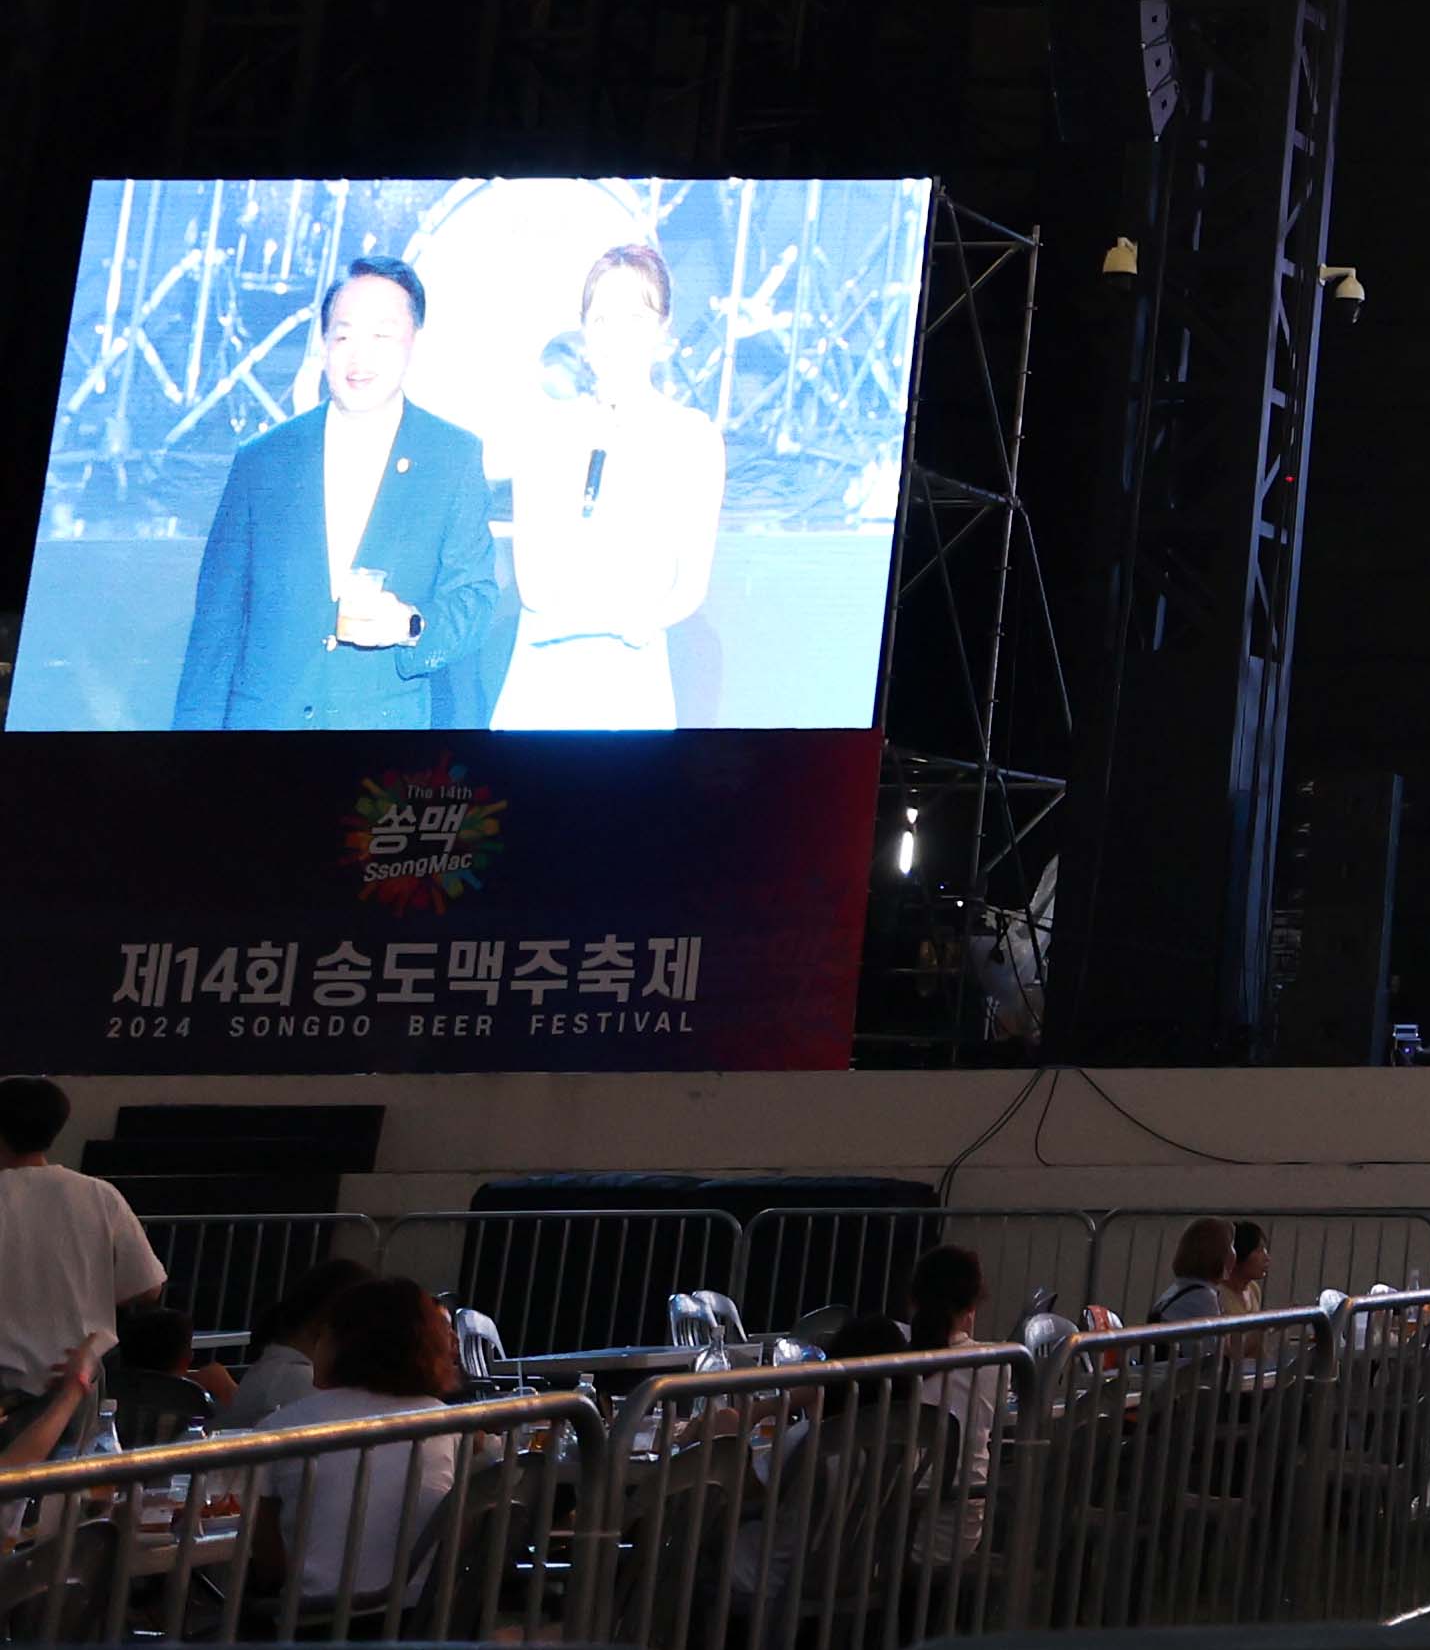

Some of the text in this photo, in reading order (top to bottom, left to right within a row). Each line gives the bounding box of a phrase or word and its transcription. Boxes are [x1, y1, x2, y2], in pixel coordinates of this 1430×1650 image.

[407, 784, 473, 799] The 14th
[368, 802, 470, 855] 쏭맥
[363, 852, 473, 883] SsongMac
[112, 933, 703, 1007] 제14회 송도맥주축제
[105, 1010, 694, 1038] 2024 SONGDO BEER FESTIVAL
